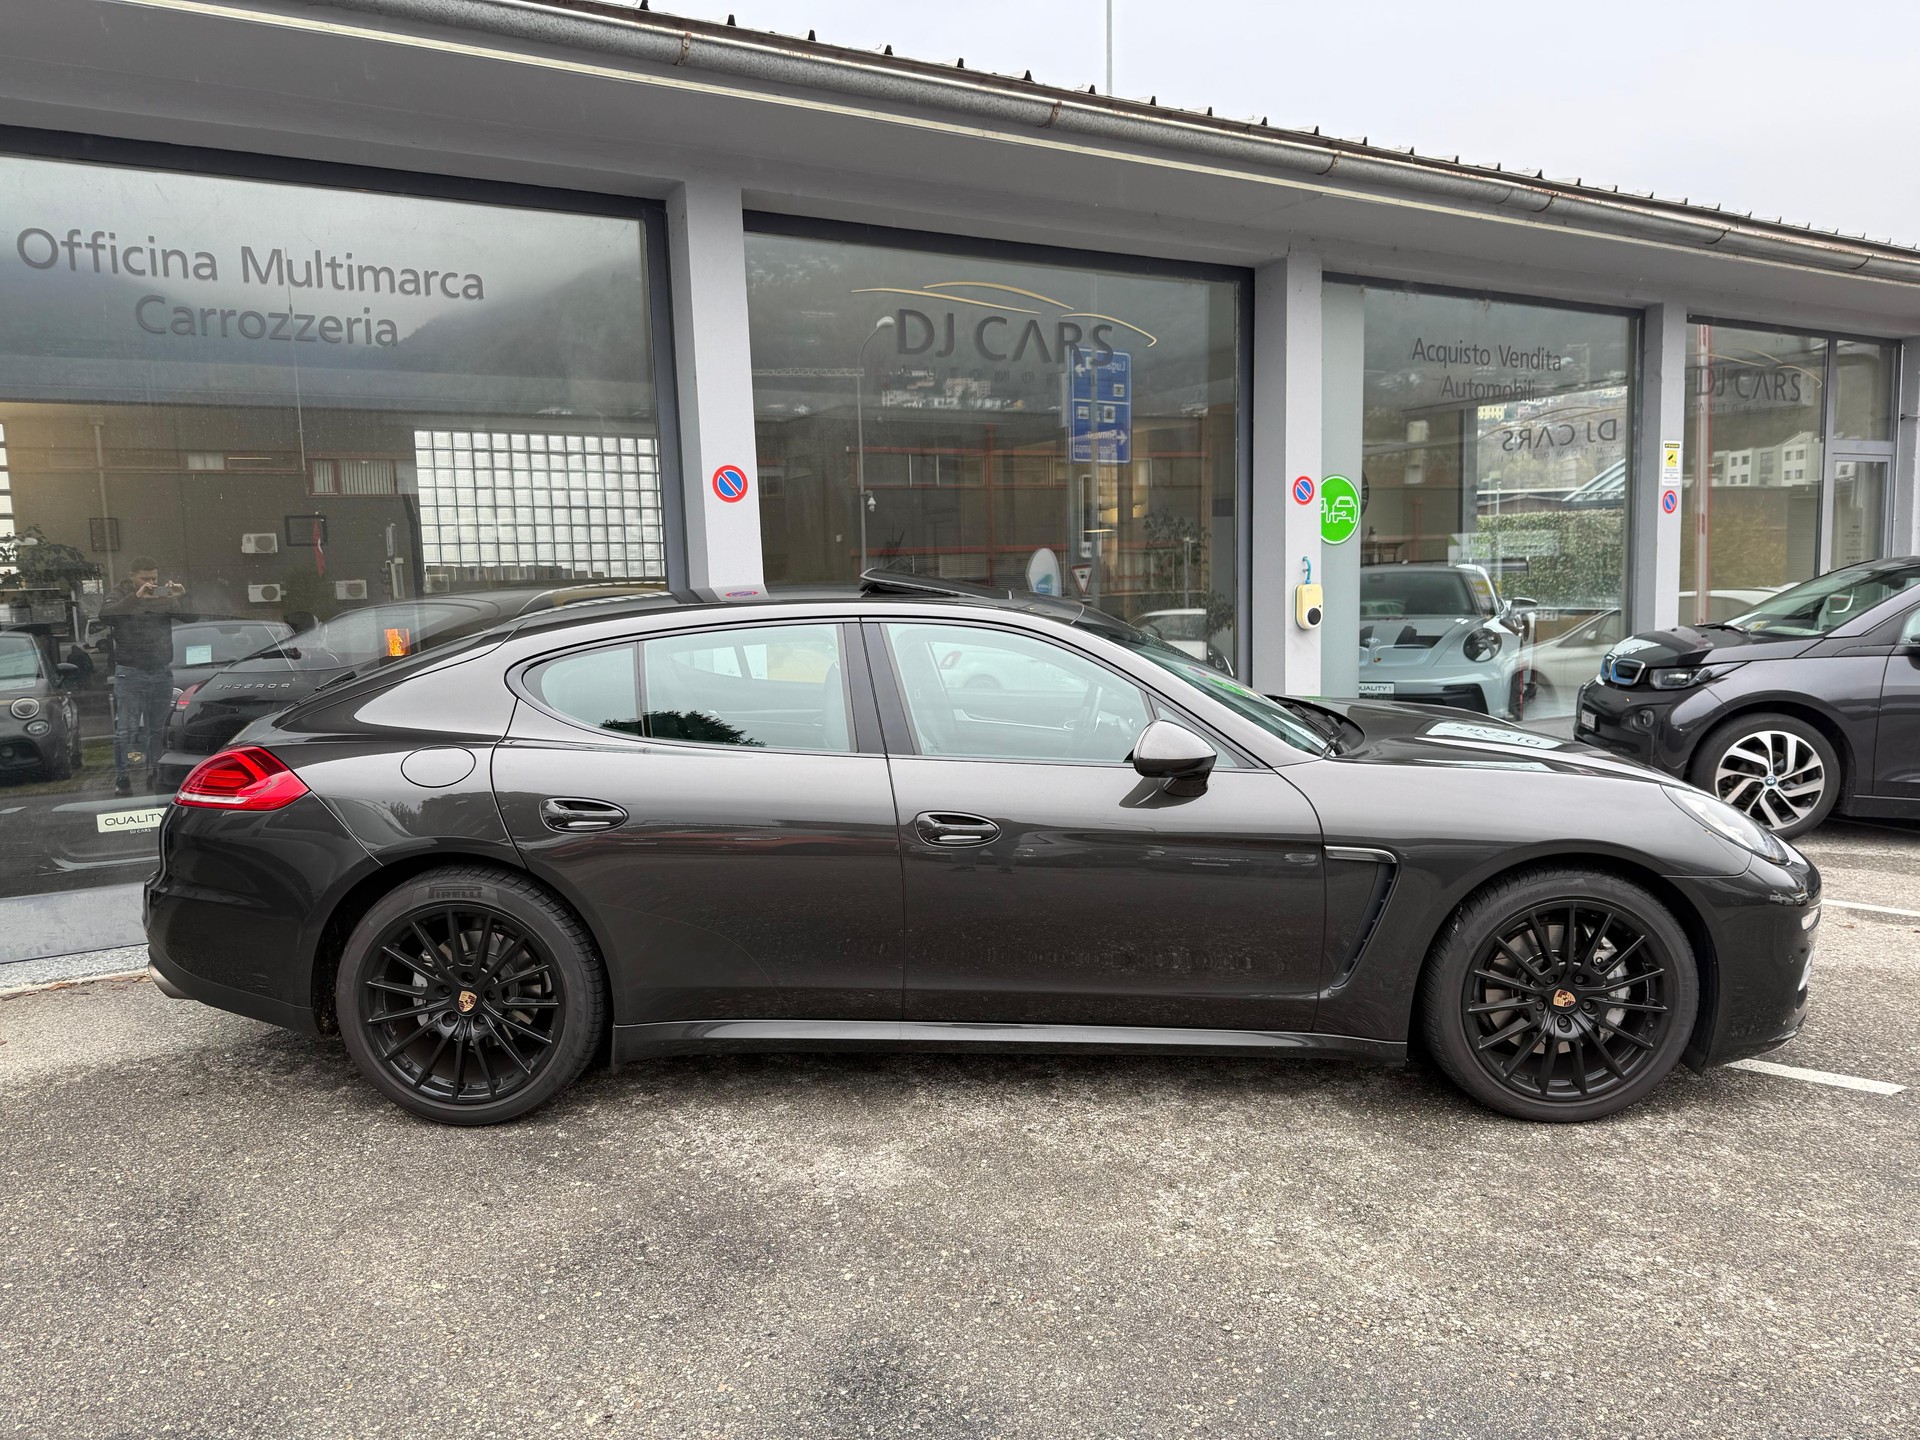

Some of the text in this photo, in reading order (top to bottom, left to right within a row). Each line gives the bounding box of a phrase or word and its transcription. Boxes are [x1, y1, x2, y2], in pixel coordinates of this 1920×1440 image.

[17, 227, 484, 300] Officina Multimarca
[135, 294, 398, 347] Carrozzeria
[896, 308, 1114, 366] DJ CARS
[1412, 337, 1561, 371] Acquisto Vendita
[1441, 375, 1535, 402] Automobili
[1734, 369, 1802, 402] CARS
[428, 886, 482, 899] PIRELLI
